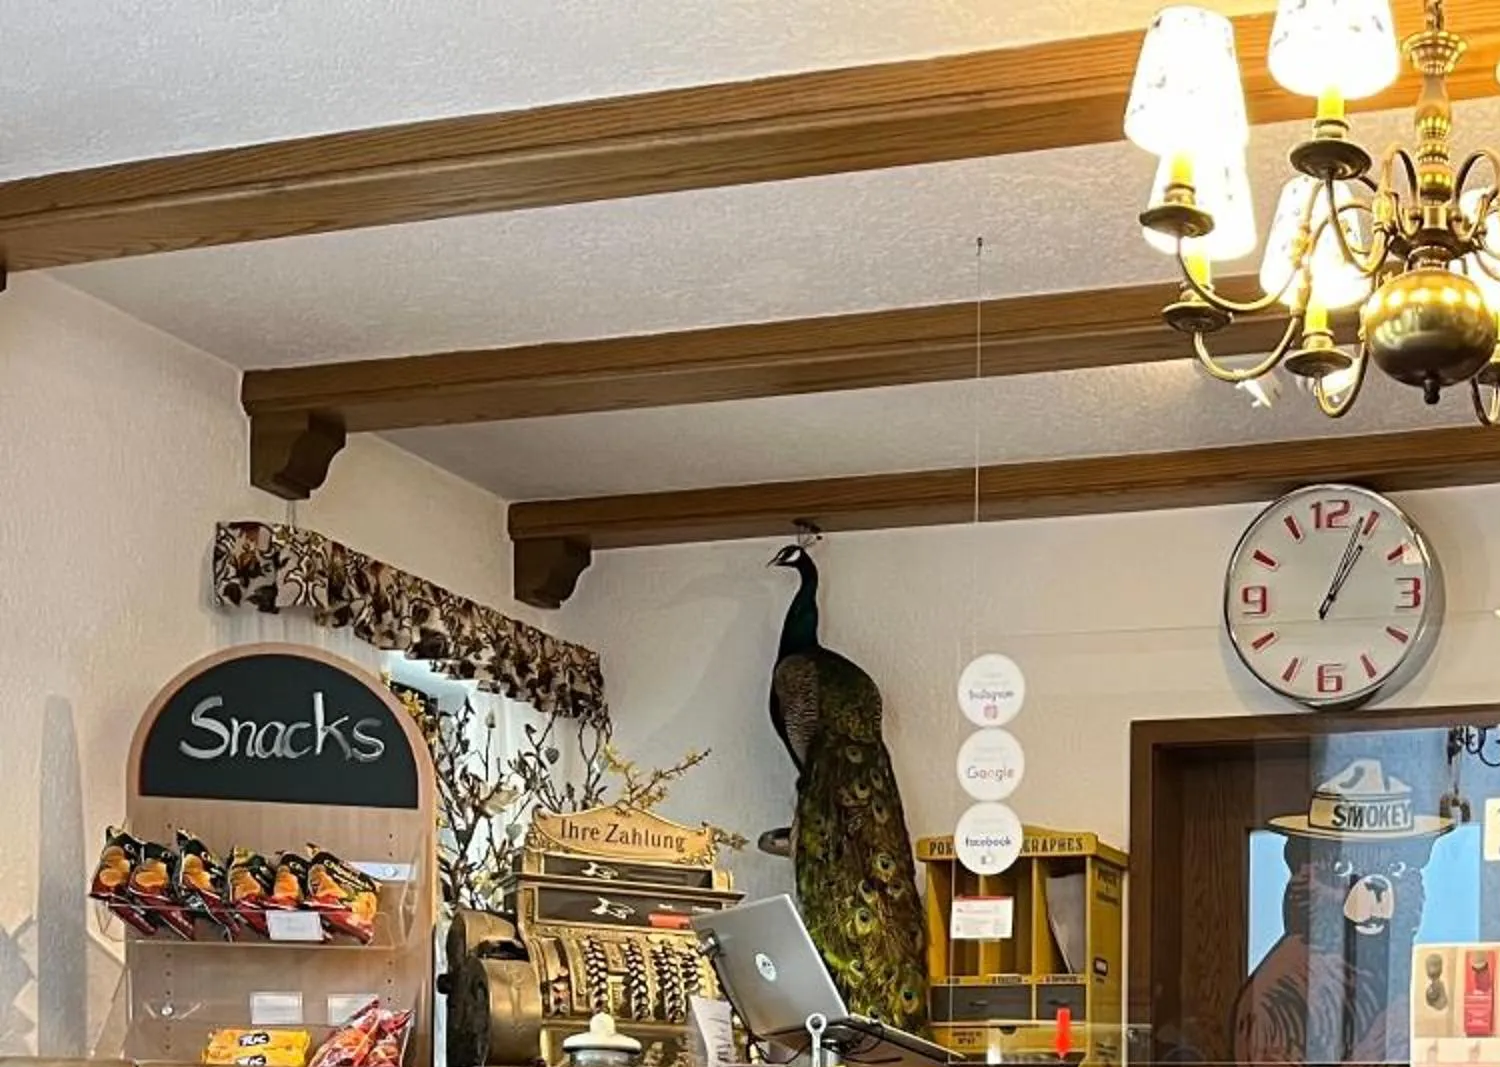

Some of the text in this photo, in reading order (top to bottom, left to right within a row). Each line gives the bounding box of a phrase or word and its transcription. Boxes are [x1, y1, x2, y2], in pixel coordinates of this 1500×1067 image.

[1309, 499, 1351, 529] 12
[1242, 586, 1268, 615] 9
[1395, 577, 1422, 609] 3
[1317, 664, 1344, 693] 6
[178, 691, 386, 763] Snacks
[966, 765, 1014, 781] Google
[1331, 803, 1412, 828] SMOKEY
[560, 819, 688, 853] Ihre Zahlung
[965, 835, 1012, 848] facebook
